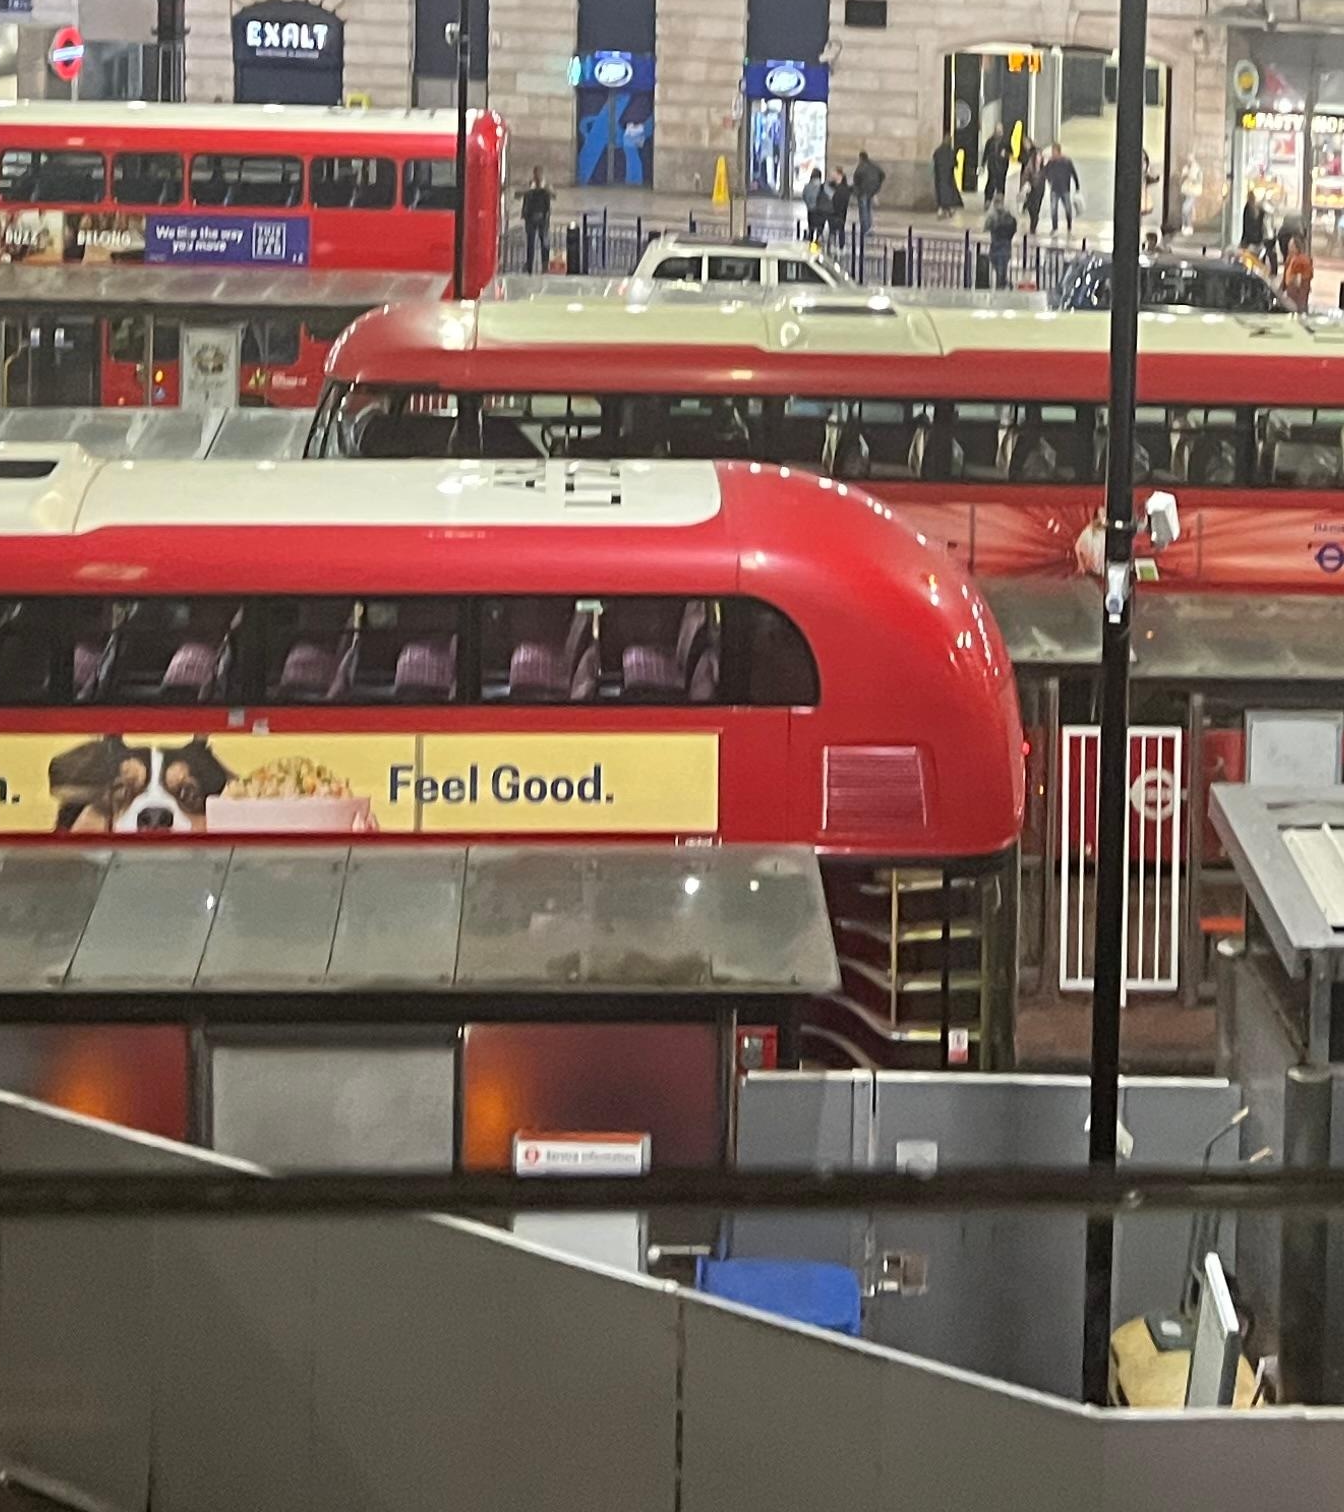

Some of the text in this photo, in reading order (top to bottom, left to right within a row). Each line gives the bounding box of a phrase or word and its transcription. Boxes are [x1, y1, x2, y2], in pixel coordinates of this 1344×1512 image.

[246, 20, 328, 50] EXALT
[77, 230, 131, 246] BELONG
[389, 762, 614, 805] Feel Good.
